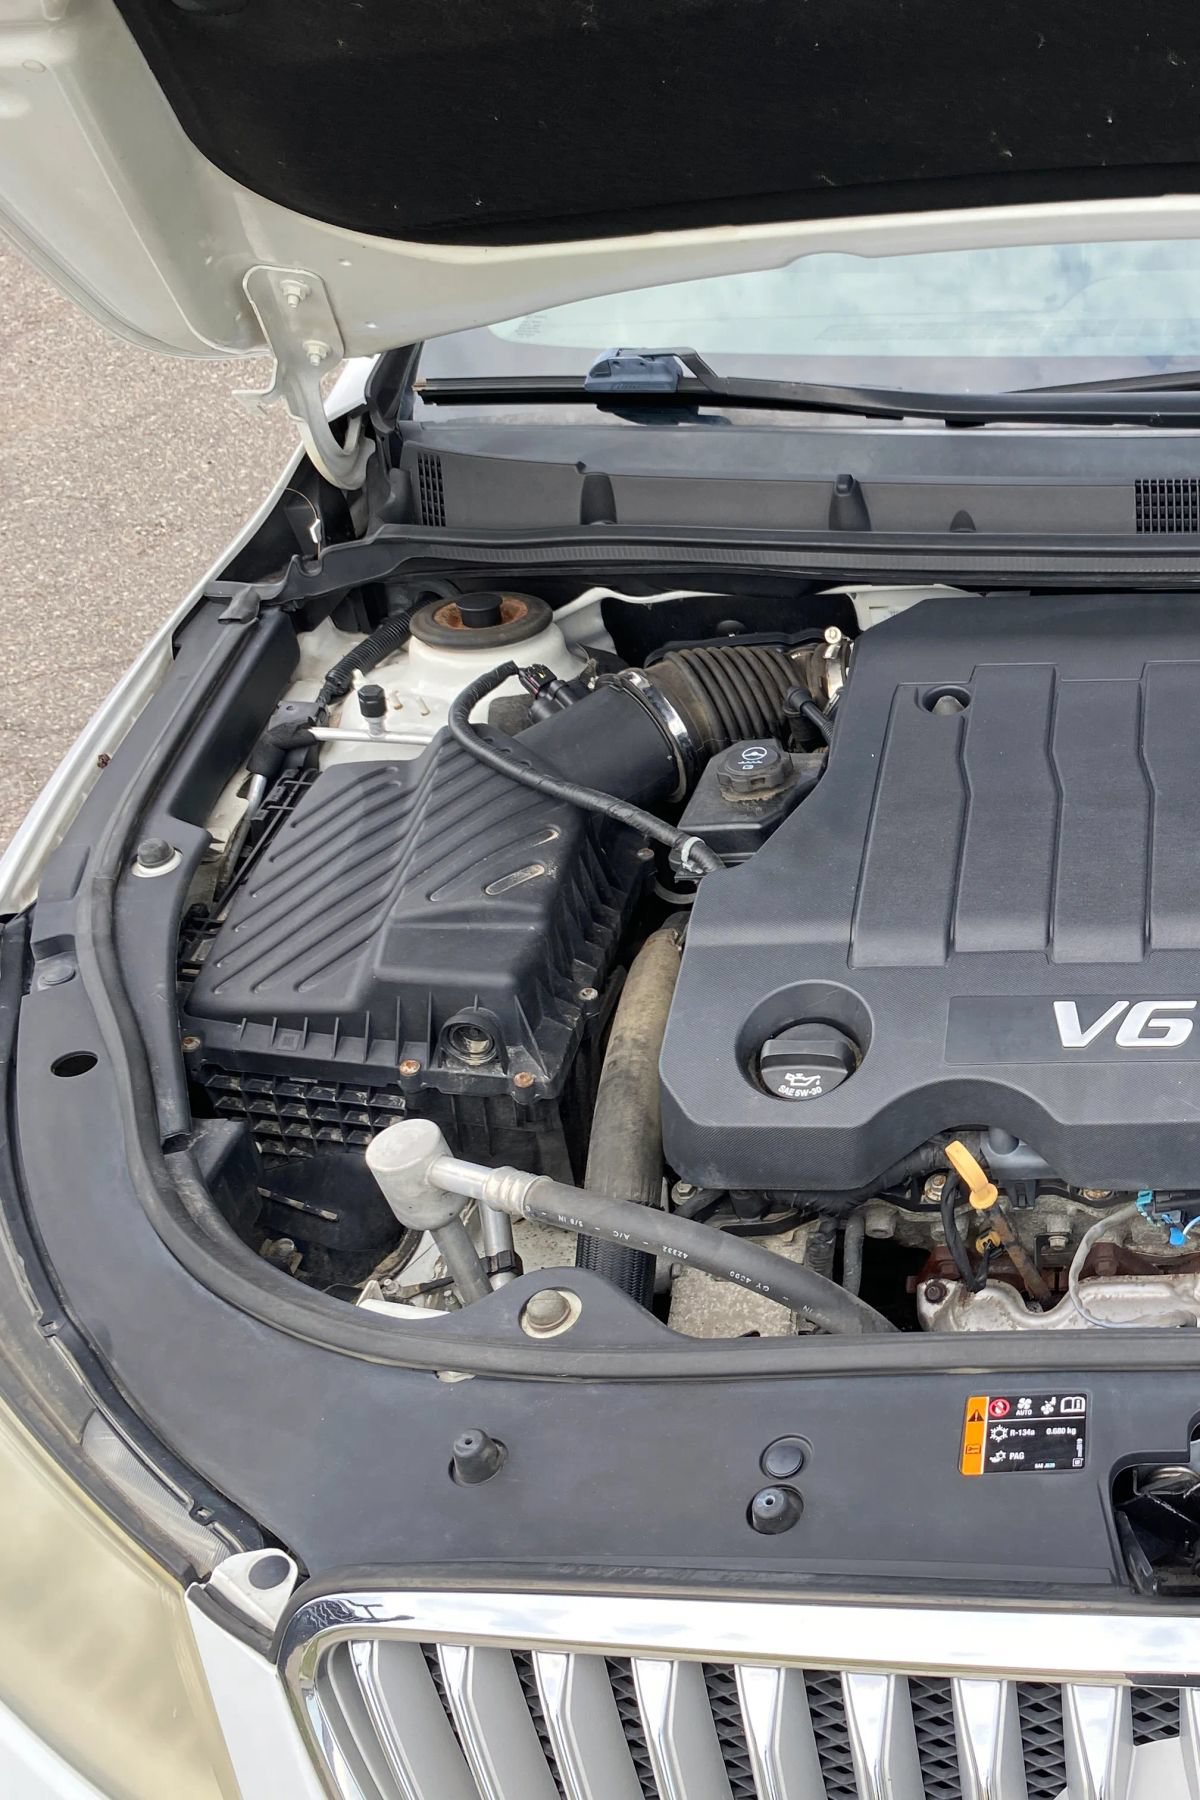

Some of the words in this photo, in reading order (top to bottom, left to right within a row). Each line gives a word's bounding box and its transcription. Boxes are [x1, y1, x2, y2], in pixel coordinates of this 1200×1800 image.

[1052, 1000, 1198, 1048] V6
[778, 1085, 793, 1096] SAE
[794, 1086, 822, 1097] 5W-30
[1009, 1428, 1036, 1437] R-134a
[1066, 1427, 1077, 1436] kg
[1009, 1452, 1025, 1460] PAG
